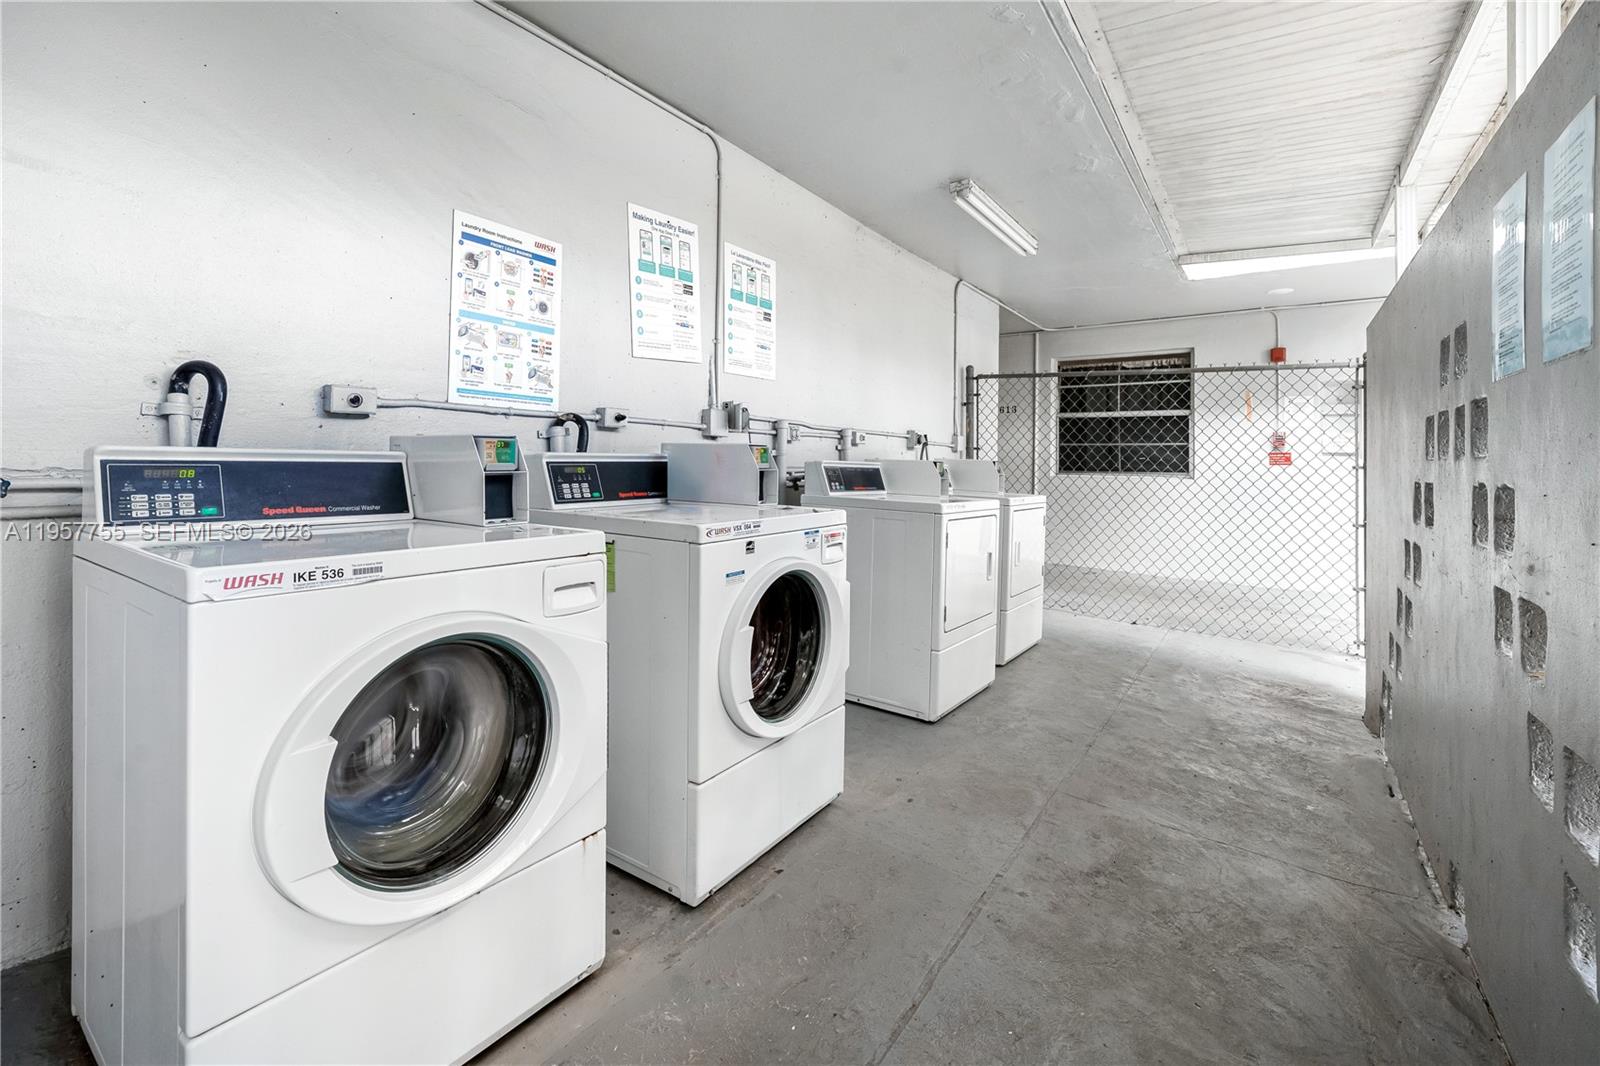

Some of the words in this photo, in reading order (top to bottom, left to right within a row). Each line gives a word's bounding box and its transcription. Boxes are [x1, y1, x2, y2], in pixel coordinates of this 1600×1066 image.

[632, 211, 654, 225] Making
[654, 218, 678, 232] Laundry
[461, 221, 482, 233] Laundry
[482, 228, 496, 236] Room
[496, 233, 523, 245] Instructions
[534, 241, 557, 254] WASH
[999, 405, 1018, 414] 613
[262, 506, 295, 516] Speed
[294, 504, 327, 513] Queen
[328, 504, 361, 512] Commercial
[361, 503, 381, 511] Washer
[223, 572, 285, 590] WASH
[293, 570, 317, 583] IKE
[321, 568, 345, 580] 536
